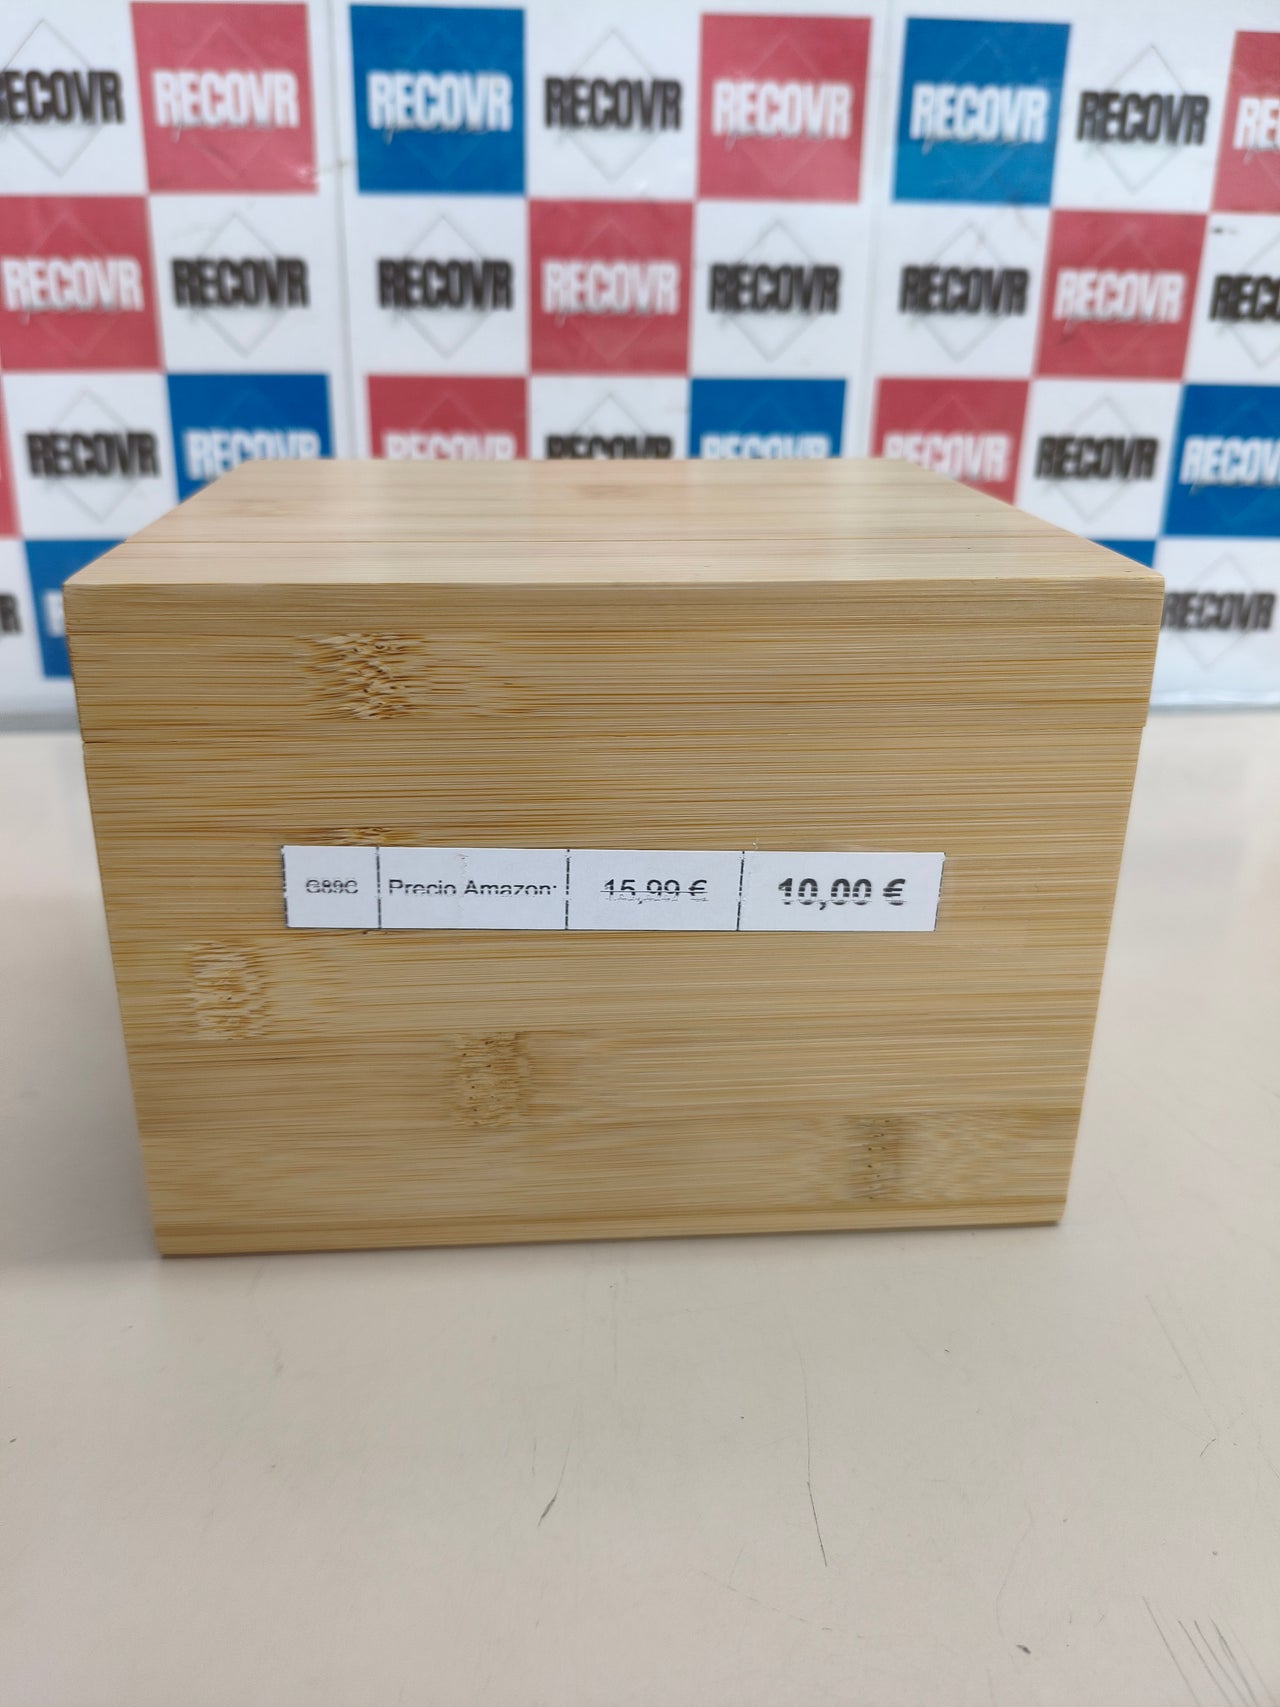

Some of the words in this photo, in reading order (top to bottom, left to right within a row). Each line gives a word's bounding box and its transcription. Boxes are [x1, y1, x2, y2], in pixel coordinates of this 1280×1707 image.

[152, 70, 299, 128] RECOVR
[367, 71, 513, 131] RECOVR
[545, 78, 683, 130] RECOVR
[711, 81, 852, 139] RECOVR
[910, 84, 1052, 141] RECOVR
[1077, 91, 1210, 145] RECOVR
[2, 257, 144, 311] RECOVR
[171, 258, 309, 308] RECOVR
[377, 259, 513, 310] RECOVR
[541, 257, 679, 315] RECOVR
[708, 264, 841, 315] RECOVR
[899, 264, 1029, 317] RECOVR
[1053, 268, 1186, 323] RECOVR
[25, 432, 160, 478] RECOVR
[1036, 436, 1158, 480] RECOVR
[389, 879, 457, 895] Precio
[778, 878, 872, 910] 10,00
[882, 878, 906, 906] €
